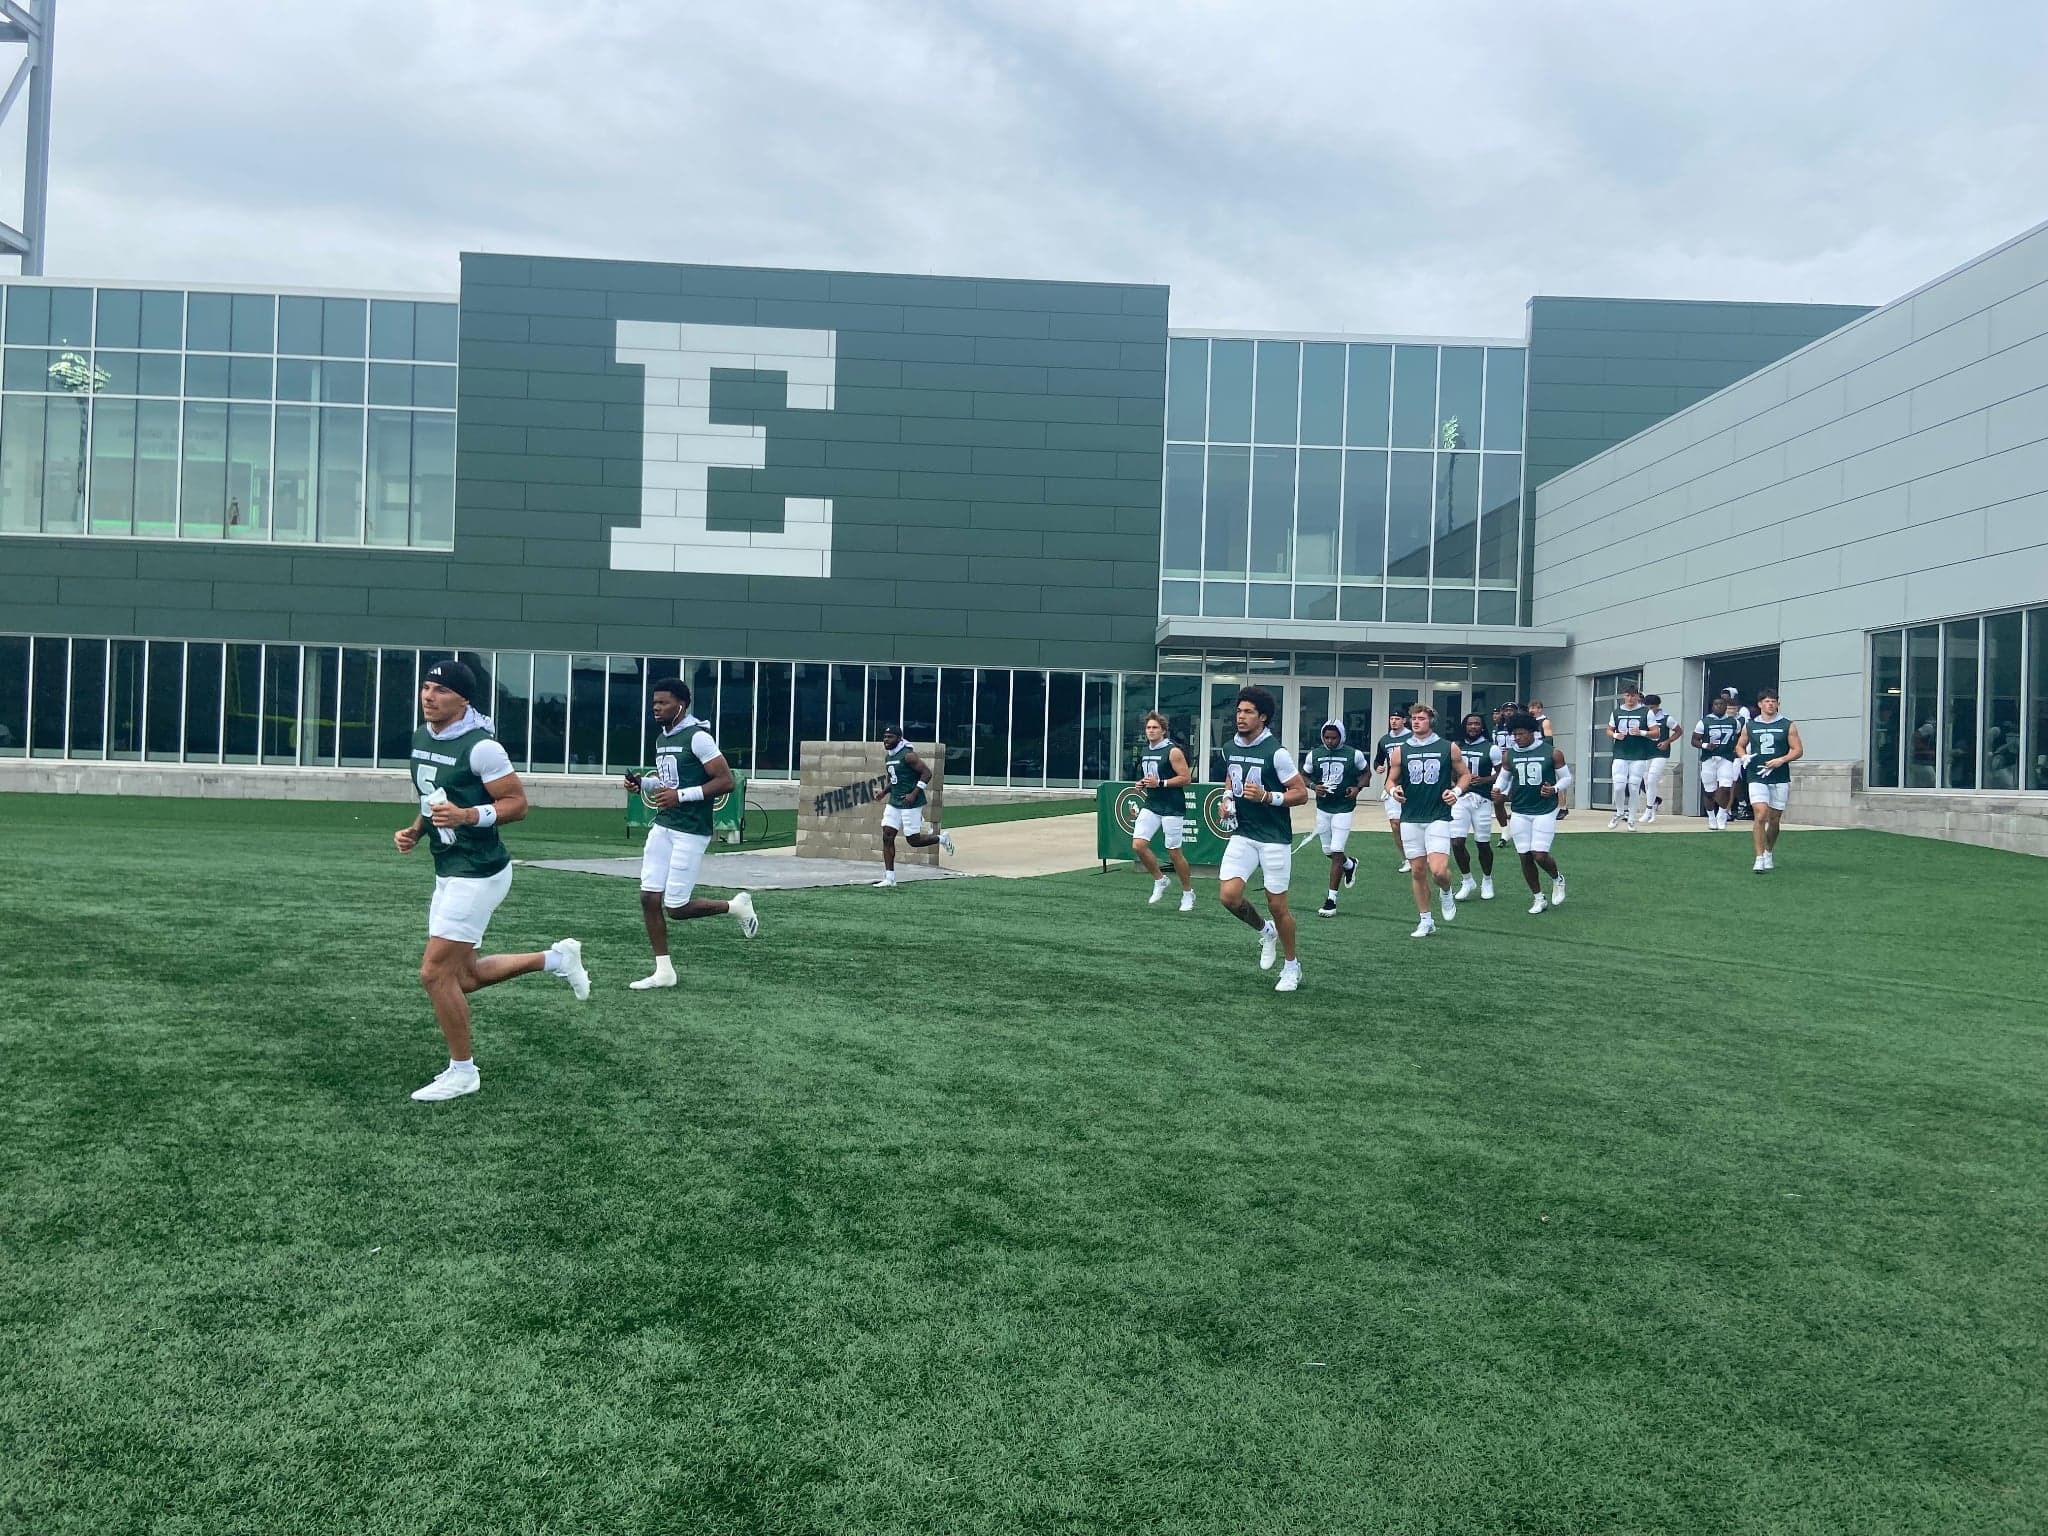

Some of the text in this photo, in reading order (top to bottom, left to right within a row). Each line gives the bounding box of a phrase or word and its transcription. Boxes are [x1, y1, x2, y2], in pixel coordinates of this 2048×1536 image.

[610, 320, 836, 578] E
[1709, 729, 1734, 745] 27
[1759, 733, 1775, 755] 2
[1515, 762, 1542, 786] 19
